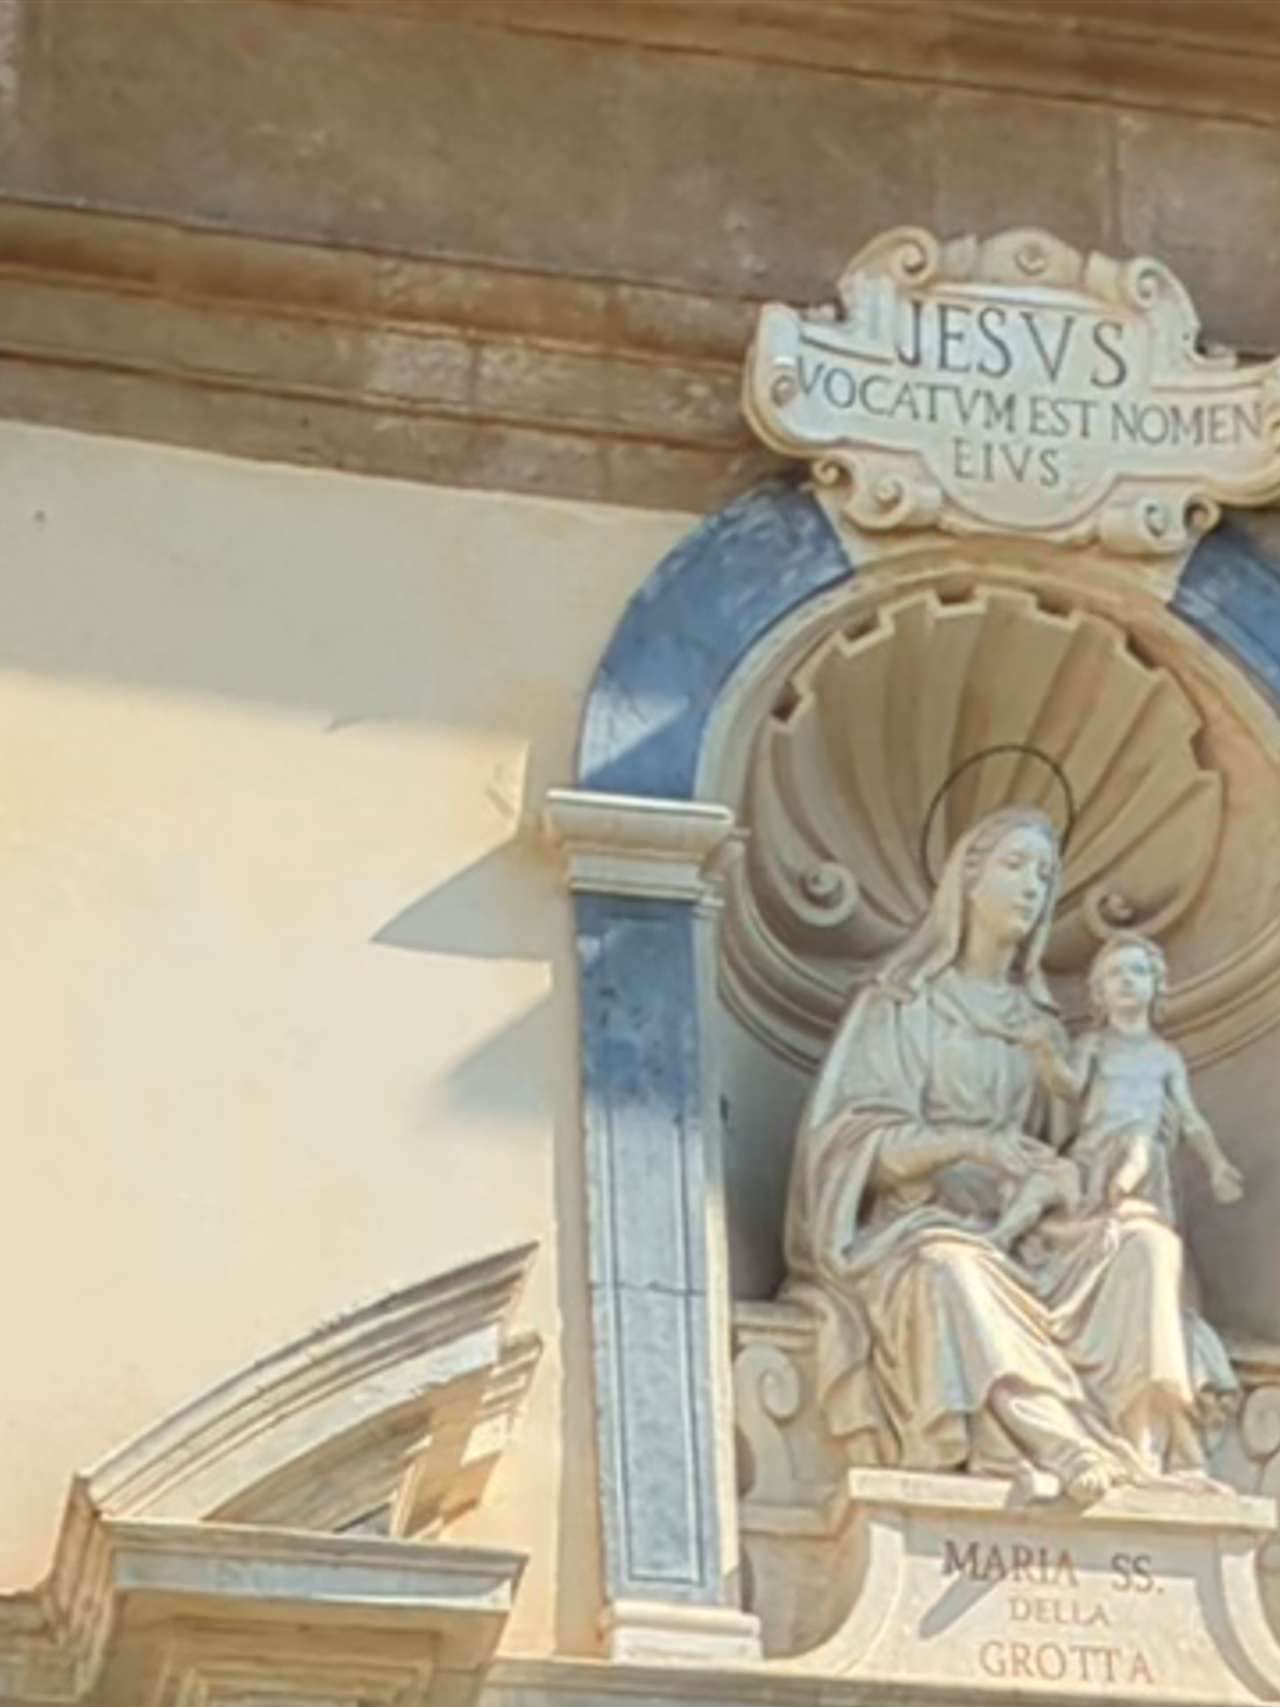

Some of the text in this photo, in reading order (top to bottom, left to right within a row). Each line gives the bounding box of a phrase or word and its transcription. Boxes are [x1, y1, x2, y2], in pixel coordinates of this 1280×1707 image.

[894, 299, 1130, 390] JESVS
[796, 353, 1262, 446] VOCATVM EST NOMEN
[952, 437, 1060, 488] EIVS
[942, 1539, 1080, 1588] MARIA
[1008, 1597, 1110, 1628] DELLA
[978, 1640, 1155, 1686] GROTTA
